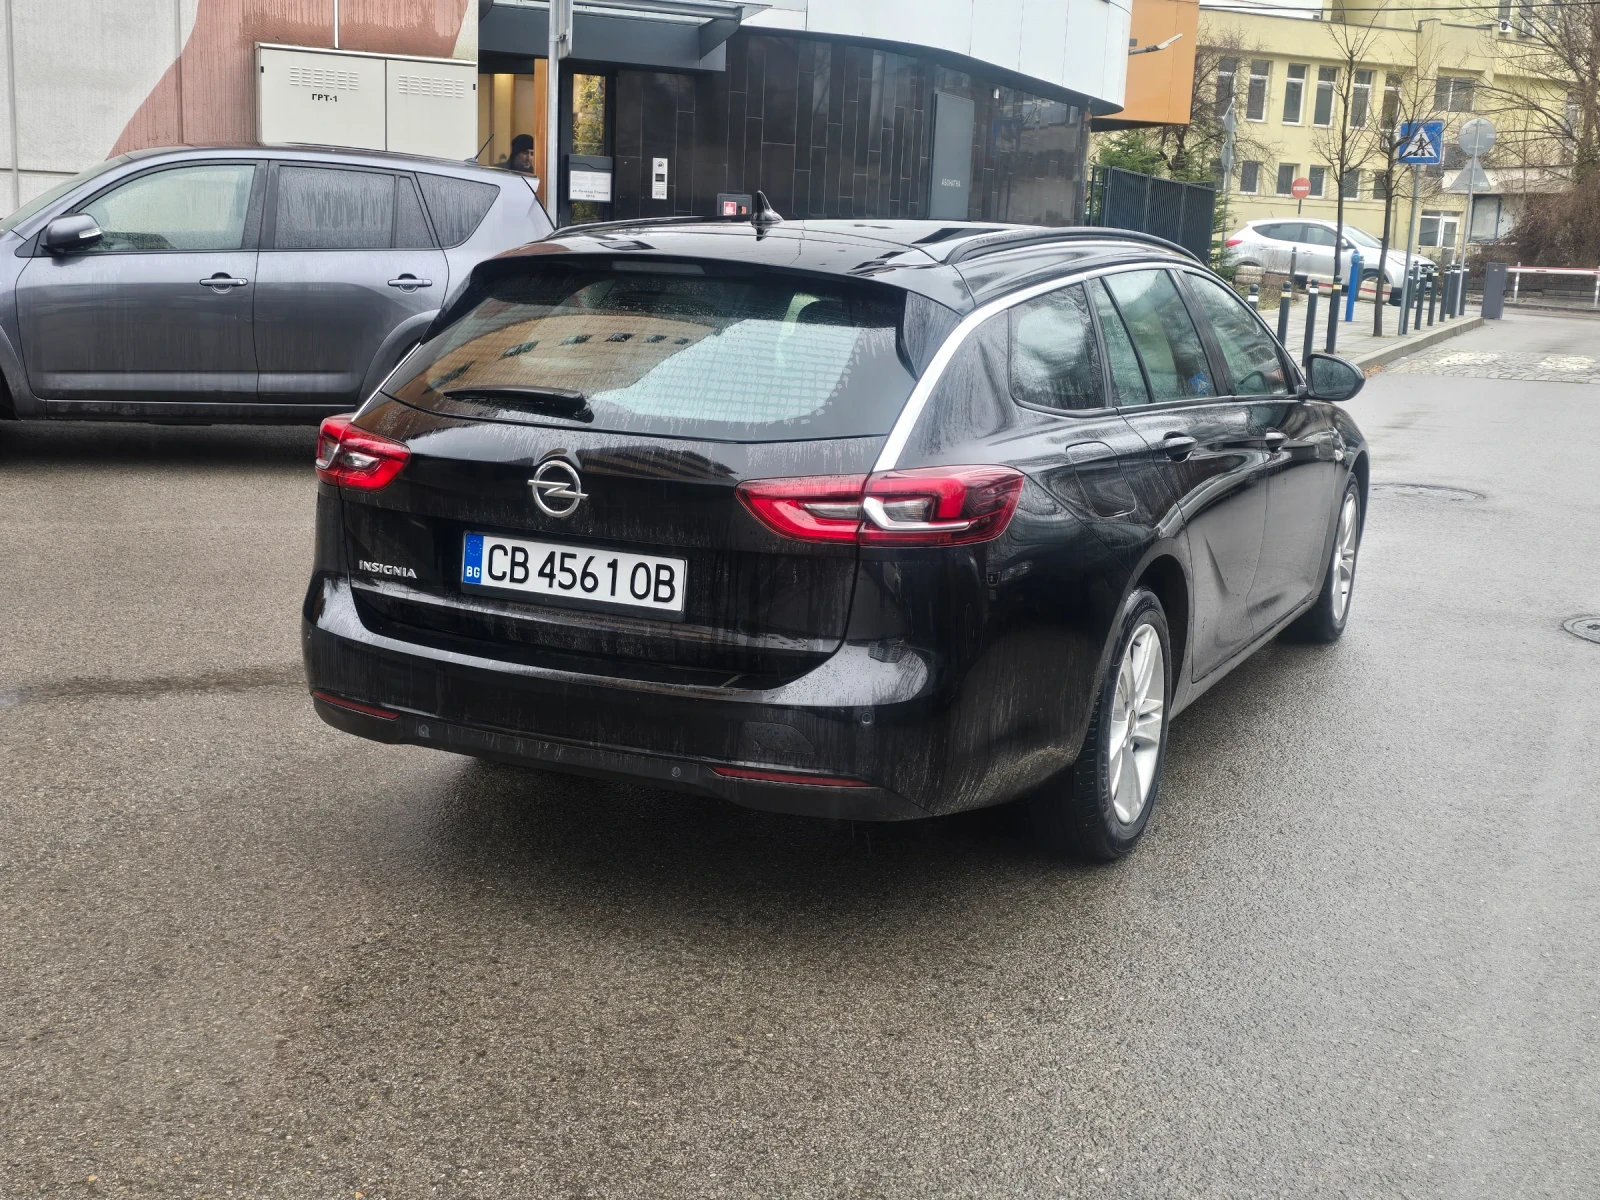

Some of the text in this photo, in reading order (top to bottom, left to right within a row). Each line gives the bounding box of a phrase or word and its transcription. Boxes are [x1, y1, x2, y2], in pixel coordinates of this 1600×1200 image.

[311, 93, 338, 103] ГРТ-1
[358, 559, 418, 579] INSIGNIA
[466, 565, 480, 578] BG
[487, 543, 676, 603] CB 4561 OB
